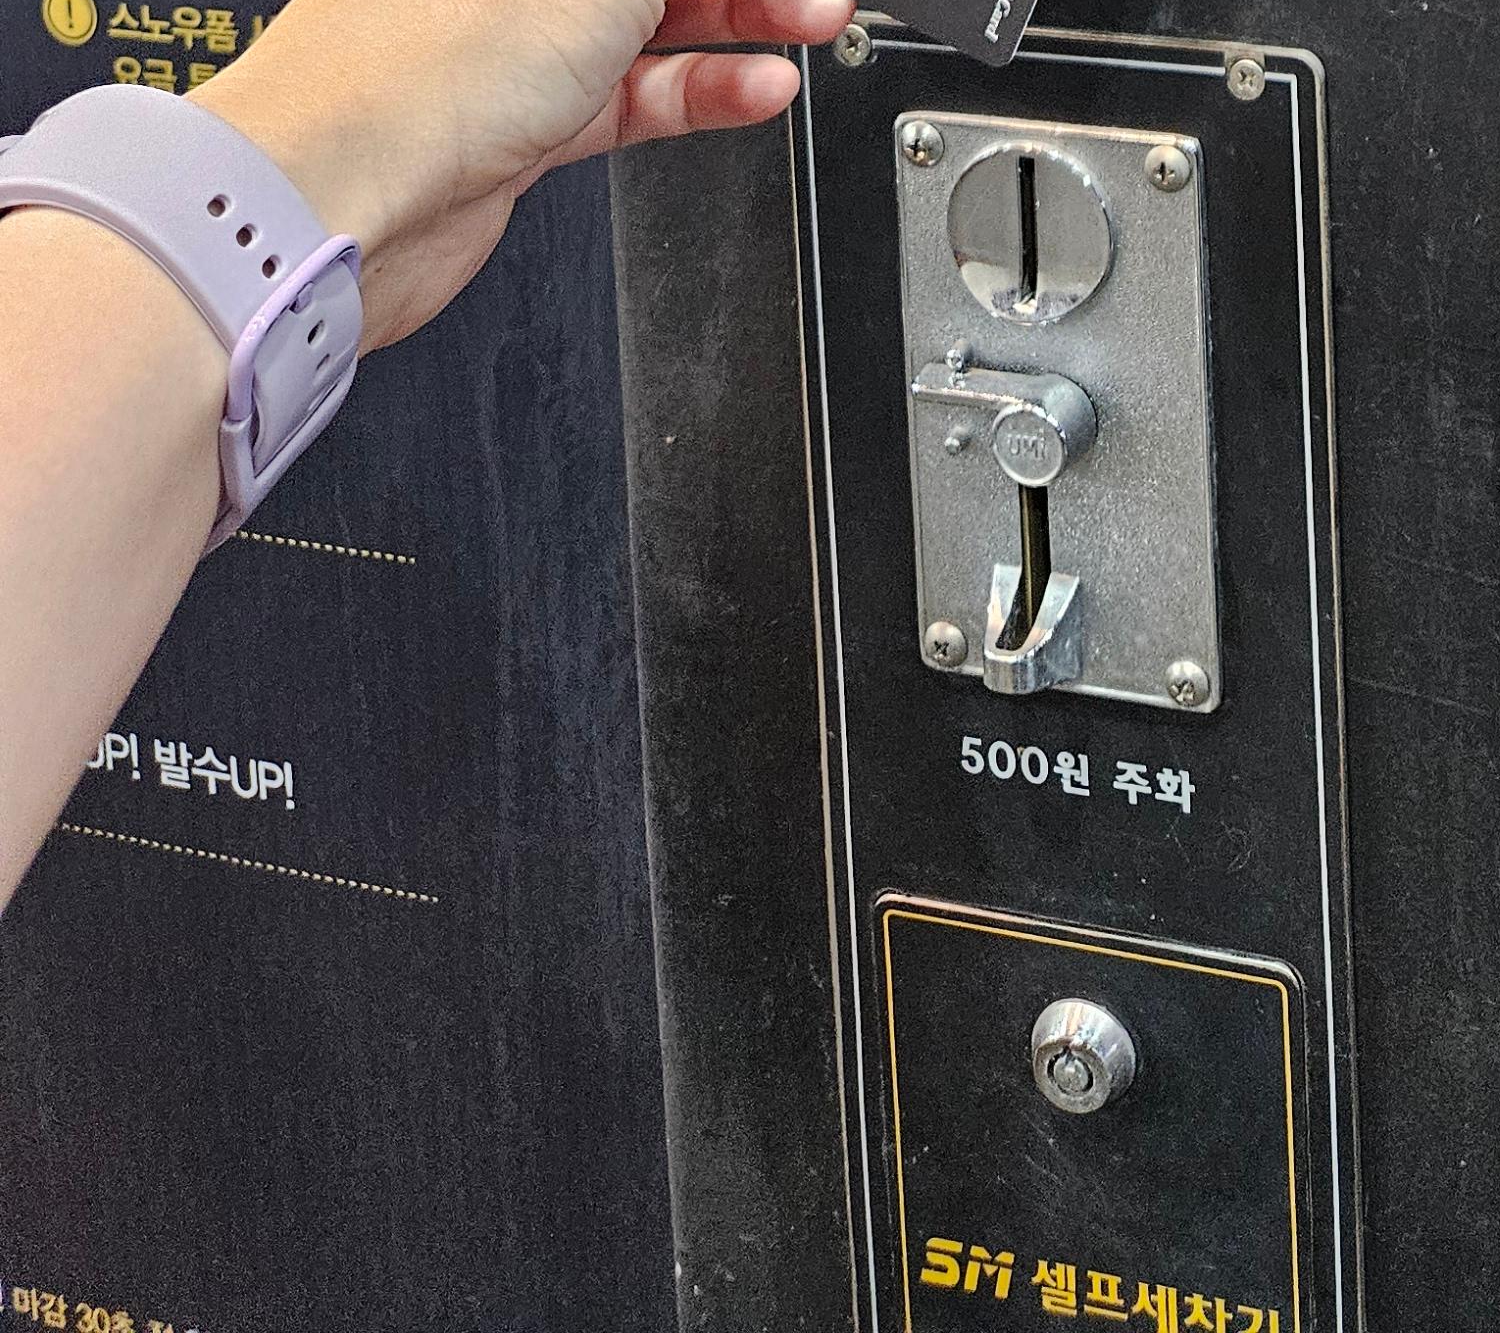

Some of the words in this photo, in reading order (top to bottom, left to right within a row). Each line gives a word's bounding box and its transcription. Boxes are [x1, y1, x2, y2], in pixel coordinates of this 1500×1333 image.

[106, 2, 240, 54] 스노우폼
[154, 738, 295, 810] 발수UP!
[961, 736, 1090, 796] 500원
[1113, 761, 1195, 813] 주화
[920, 1237, 1015, 1300] SM
[1031, 1259, 1279, 1333] 셀프세차기
